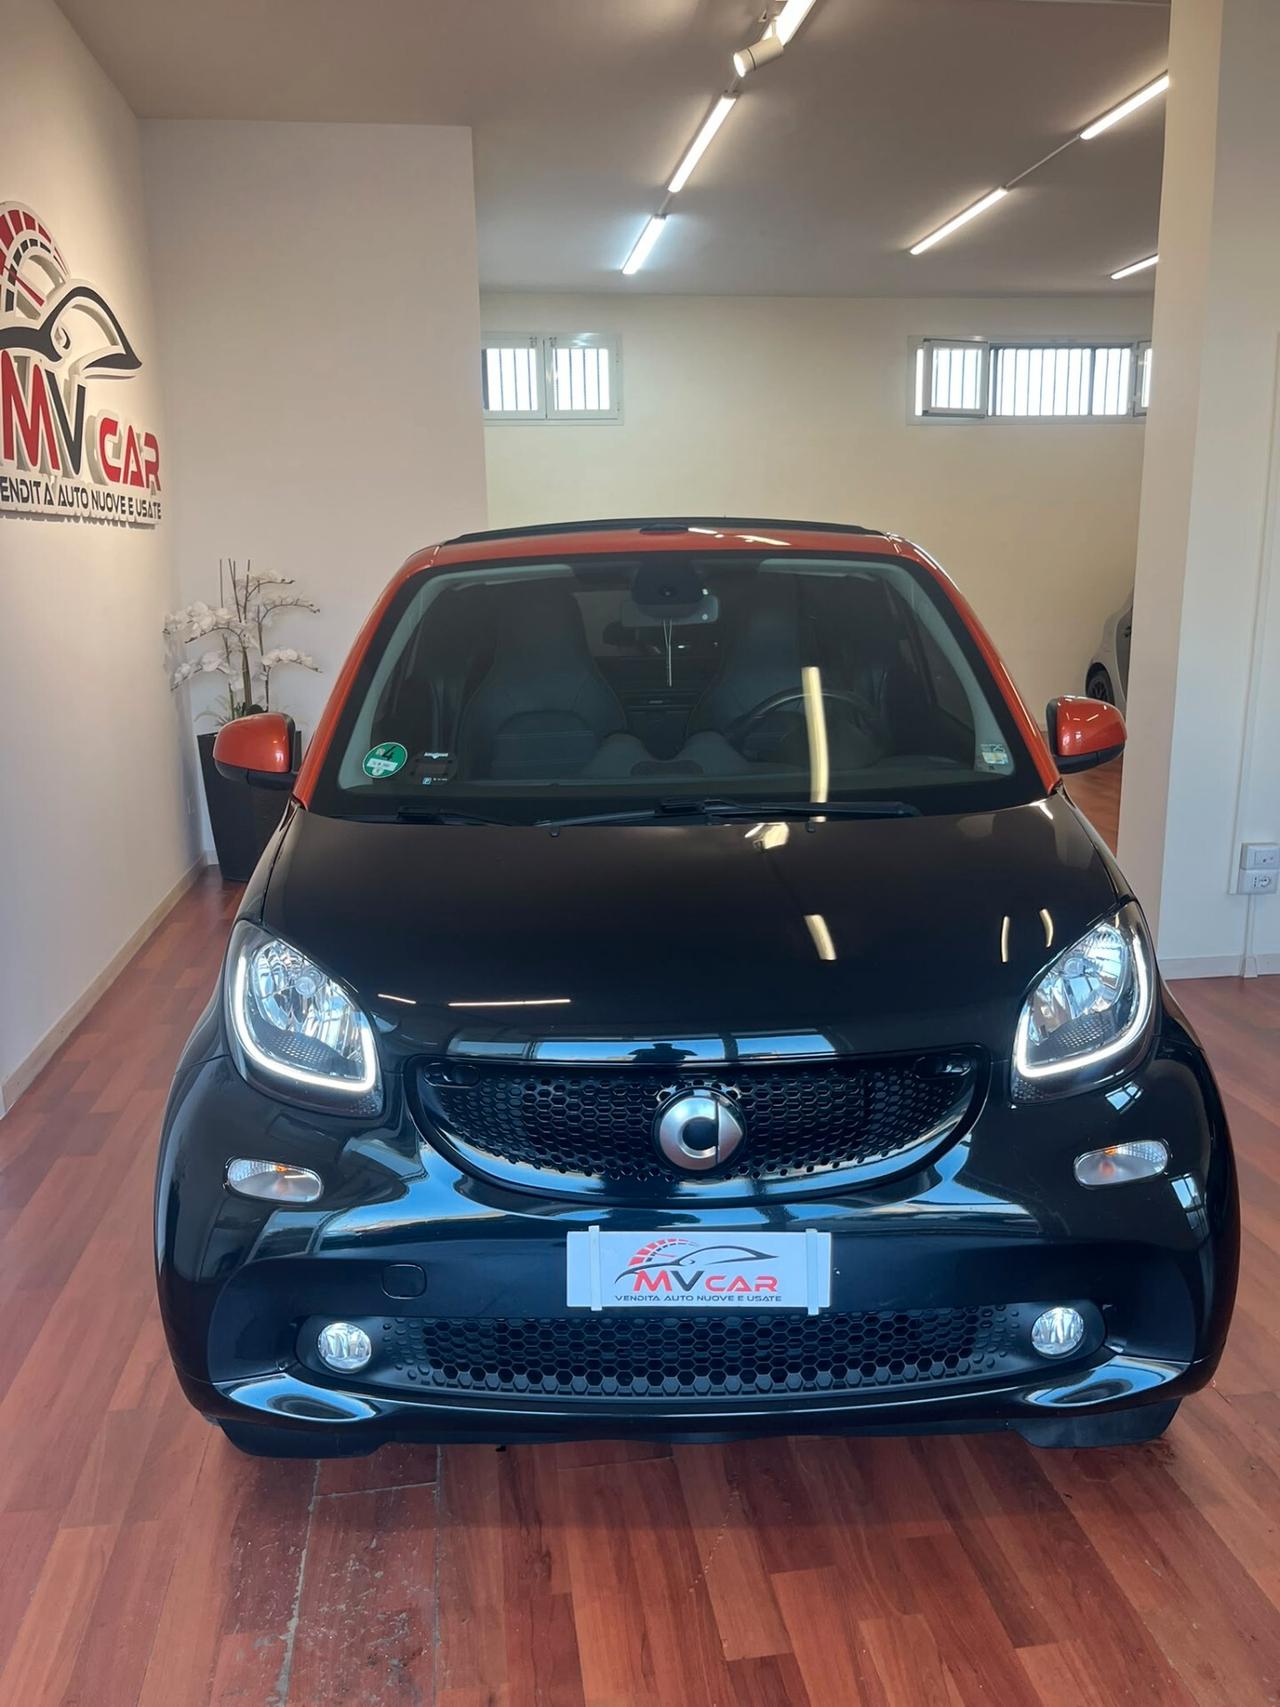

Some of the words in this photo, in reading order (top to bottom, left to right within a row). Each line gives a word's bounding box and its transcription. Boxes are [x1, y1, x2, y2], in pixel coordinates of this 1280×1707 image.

[0, 476, 54, 506] ENDITA
[58, 484, 89, 509] AUTO
[91, 490, 126, 514] NUOVE
[128, 497, 134, 515] E
[136, 499, 161, 519] USATE
[382, 746, 396, 760] 4
